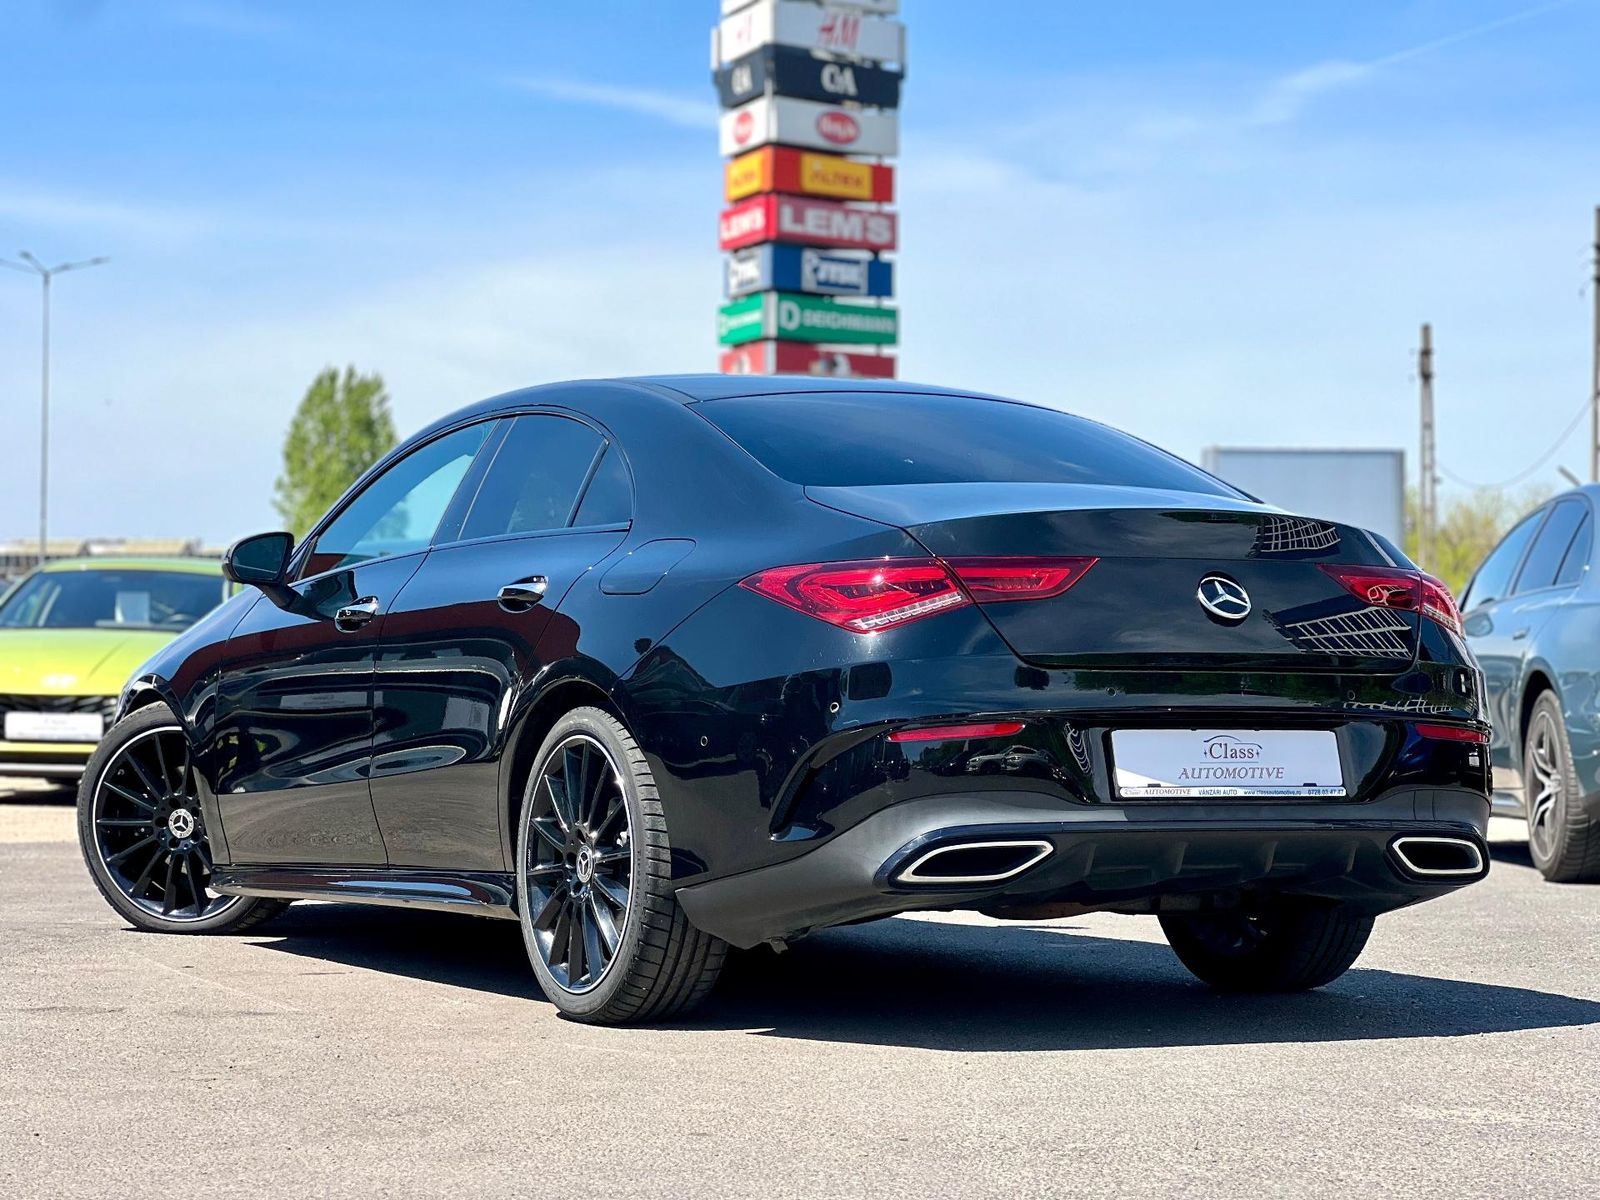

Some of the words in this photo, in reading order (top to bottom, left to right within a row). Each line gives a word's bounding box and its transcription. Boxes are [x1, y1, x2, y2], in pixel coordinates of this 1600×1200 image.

[1209, 742, 1255, 759] Class
[1178, 766, 1286, 780] AUTOMOTIVE
[1143, 788, 1193, 796] AUTOMOTIVE
